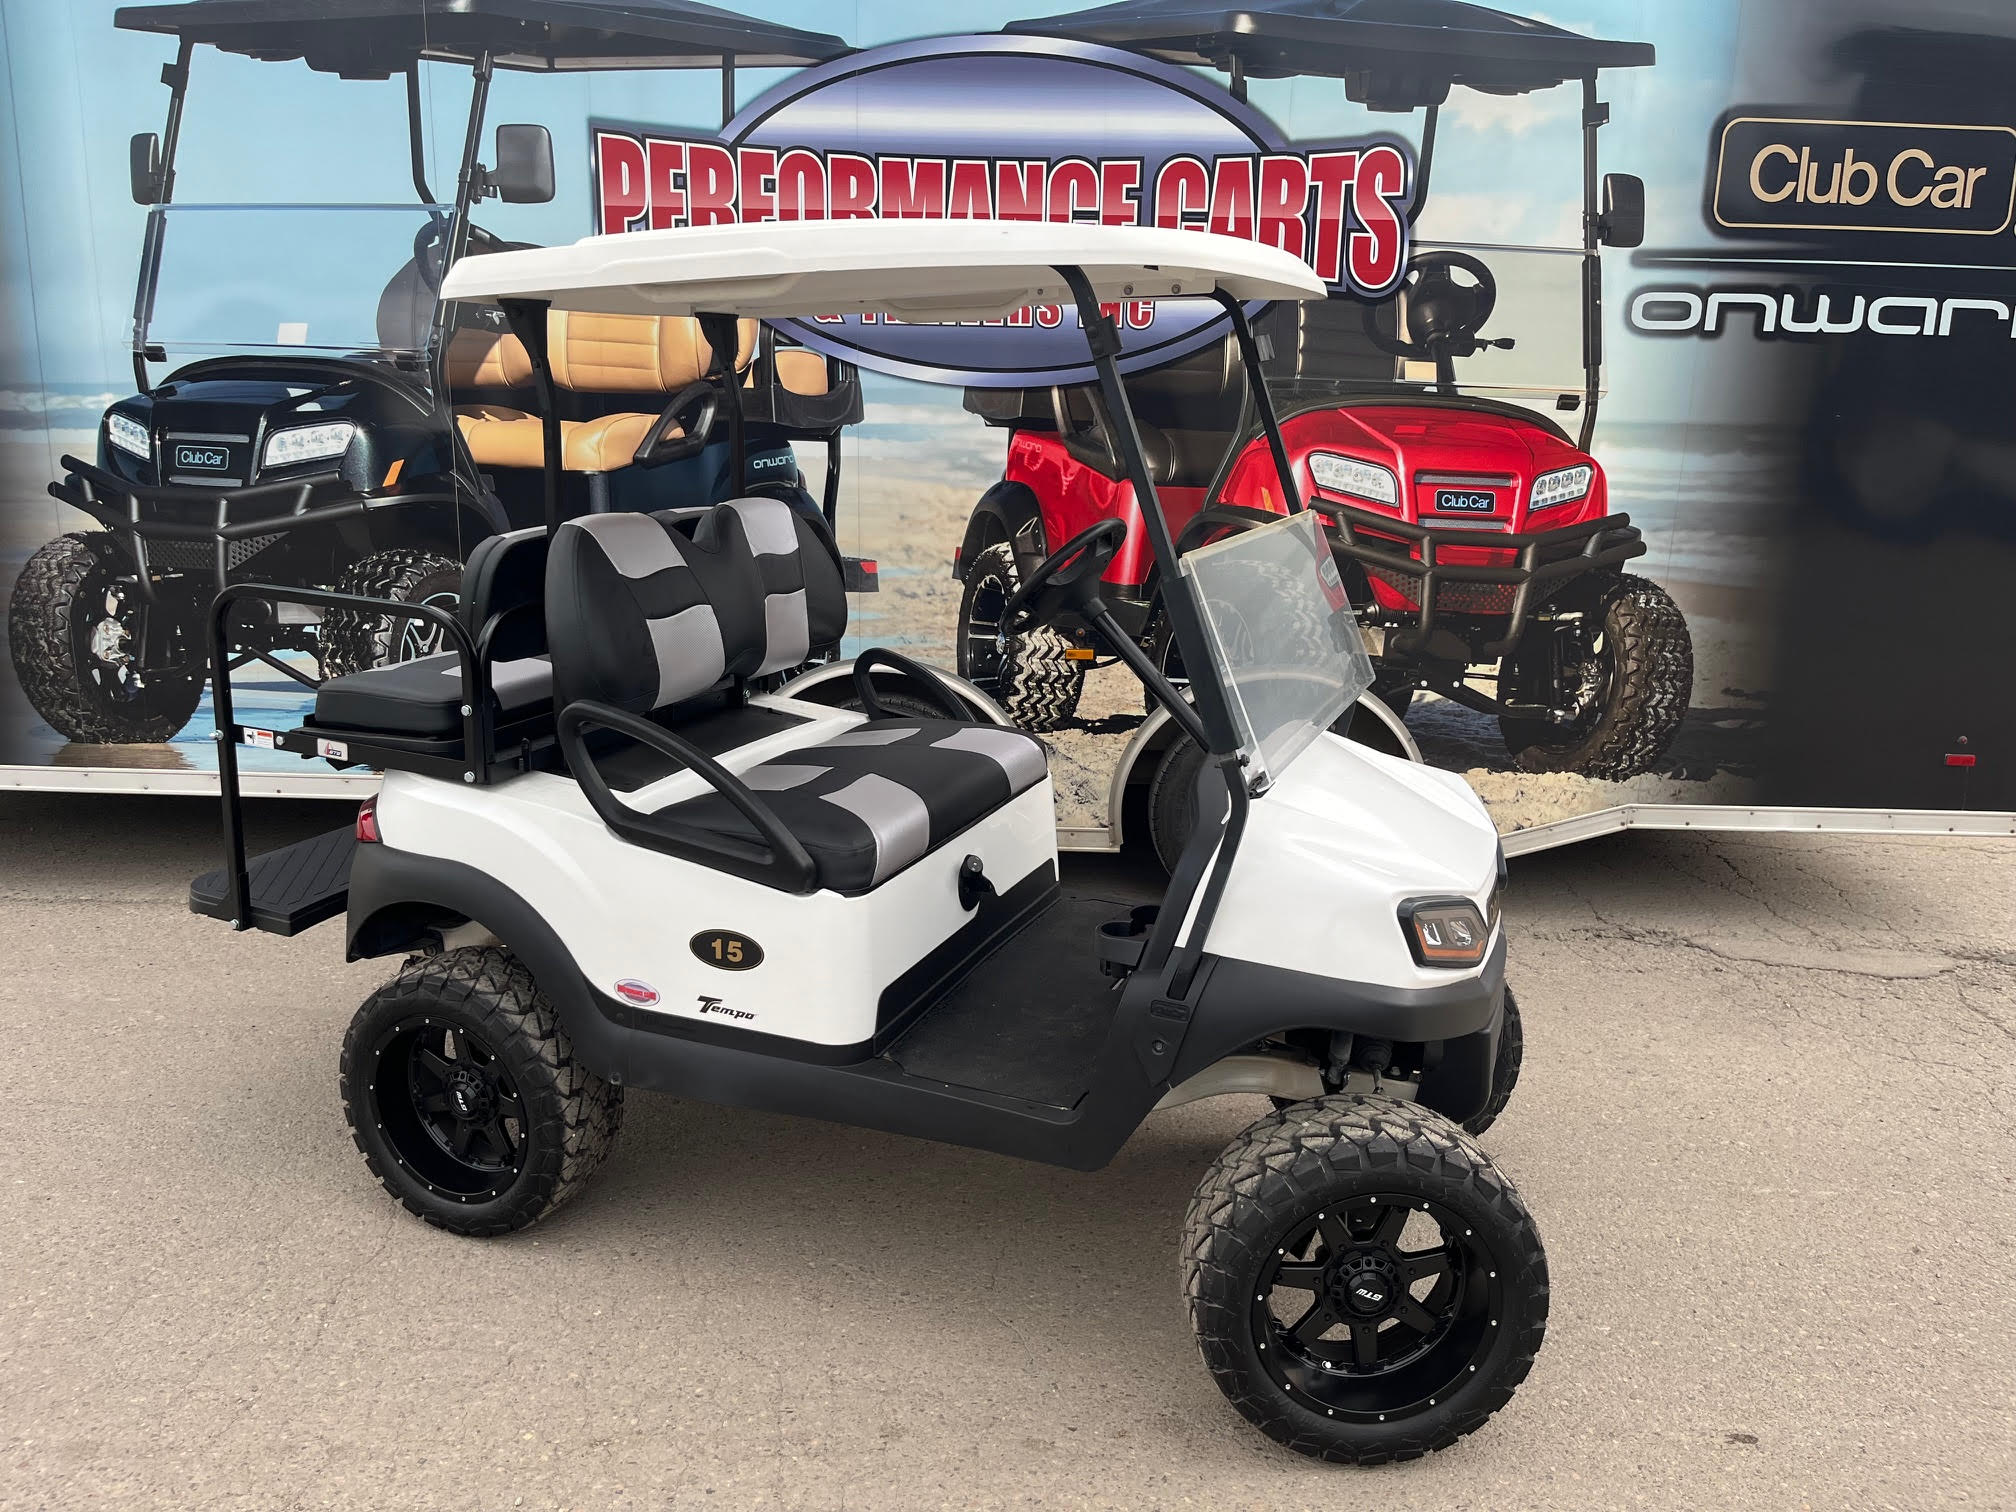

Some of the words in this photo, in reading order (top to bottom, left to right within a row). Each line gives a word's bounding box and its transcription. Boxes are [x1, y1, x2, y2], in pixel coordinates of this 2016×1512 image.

[1749, 143, 1879, 206] Club
[1886, 148, 1988, 209] Car
[595, 131, 1142, 236] PERFORMANCE
[1154, 145, 1406, 290] CARTS
[1630, 291, 2016, 340] onwar
[181, 450, 204, 464] Club
[204, 451, 223, 465] Car
[1441, 494, 1468, 508] Club
[1469, 495, 1490, 509] Car
[711, 938, 743, 963] 15
[697, 995, 756, 1020] Tempo
[1355, 1288, 1383, 1301] GTW
